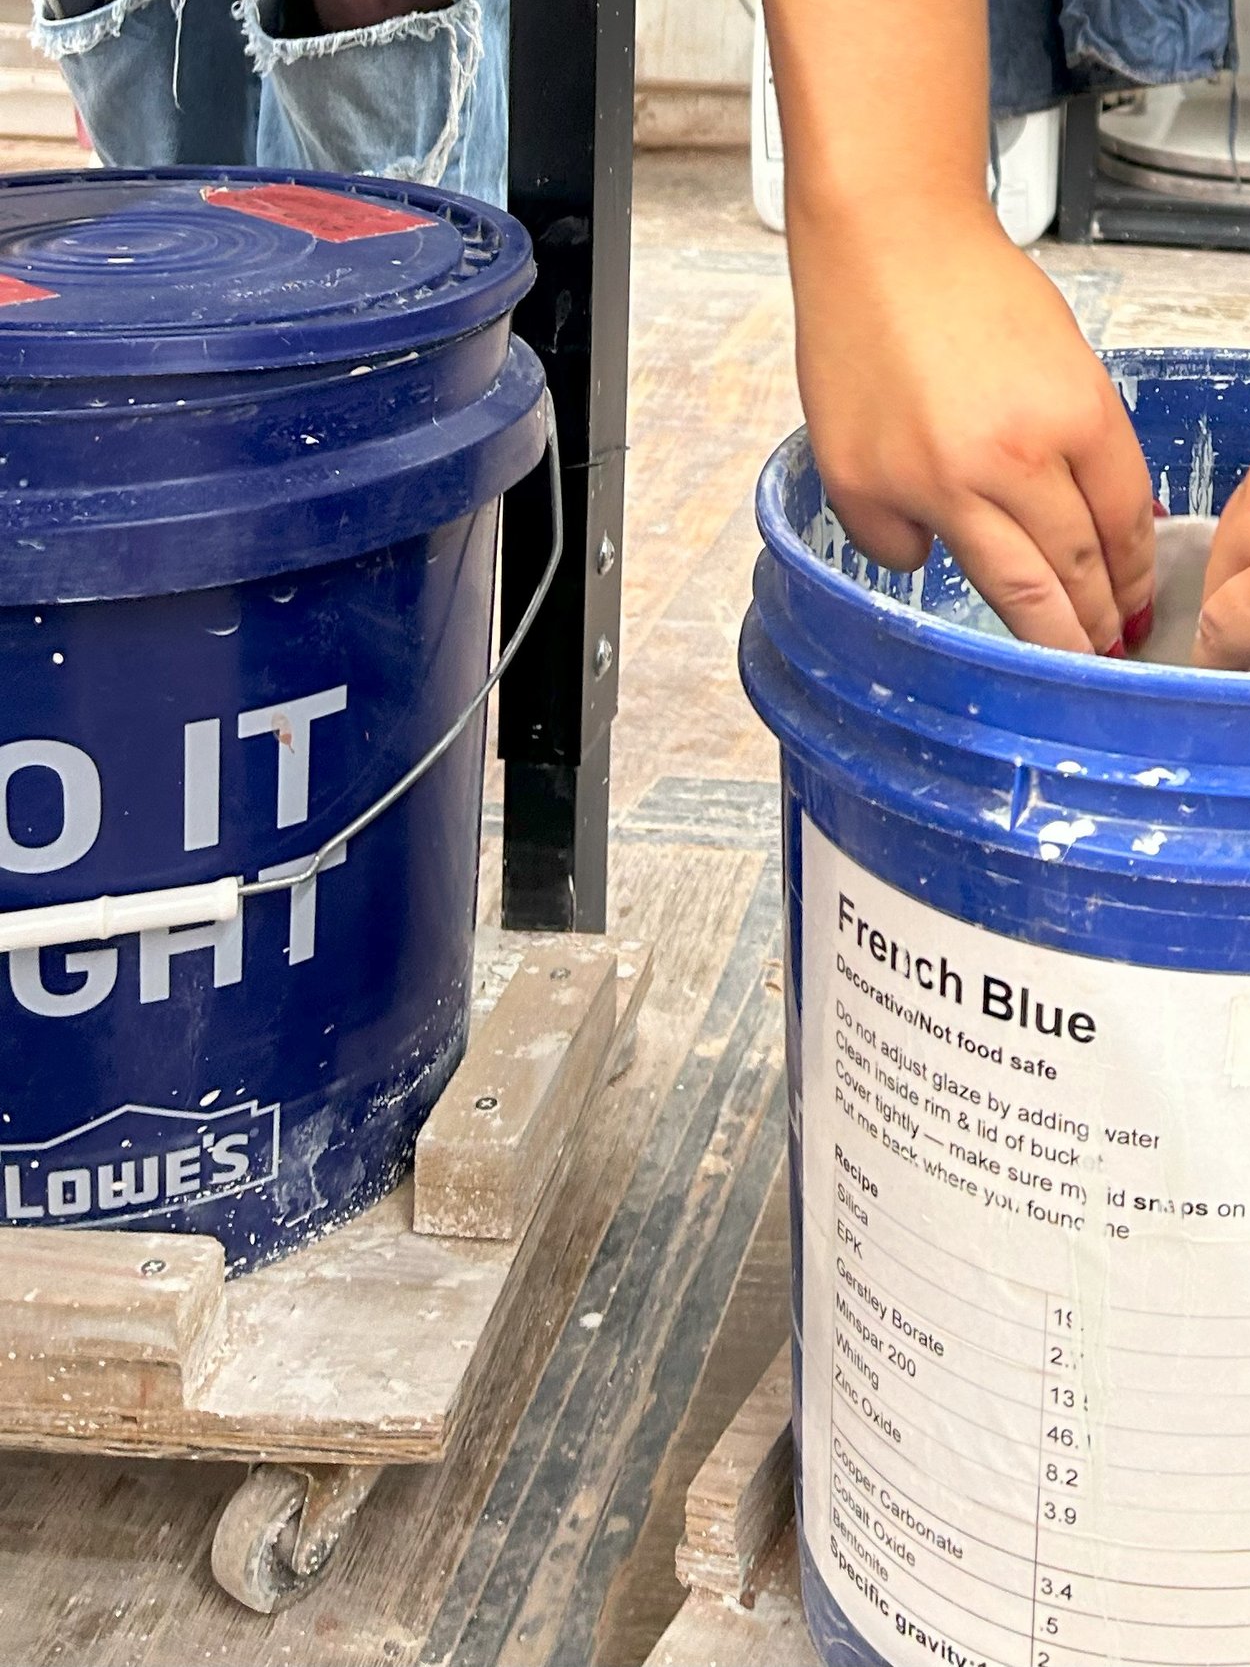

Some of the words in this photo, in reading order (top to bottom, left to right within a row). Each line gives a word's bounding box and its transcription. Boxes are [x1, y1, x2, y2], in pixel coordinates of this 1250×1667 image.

[183, 685, 348, 852] IT
[838, 890, 963, 1006] French
[982, 974, 1097, 1045] Blue
[835, 998, 854, 1029] Do
[855, 1020, 878, 1050] not
[880, 1040, 928, 1082] adjust
[932, 1072, 982, 1107] glaze
[987, 1091, 1012, 1120] by
[1017, 1107, 1091, 1143] adding
[835, 1029, 872, 1075] Clean
[874, 1061, 920, 1107] inside
[924, 1094, 952, 1124] rim
[957, 1111, 971, 1133] &
[977, 1118, 999, 1144] lid
[1004, 1134, 1026, 1153] of
[956, 1030, 1004, 1066] food
[1010, 1052, 1058, 1082] safe
[4, 1131, 250, 1220] LOWE'S
[834, 1142, 880, 1199] Recipe
[835, 1058, 873, 1103] Cover
[875, 1093, 920, 1140] tightly
[949, 1141, 1001, 1177] make
[1007, 1165, 1053, 1193] sure
[1217, 1202, 1247, 1219] on
[835, 1085, 856, 1121] Put
[857, 1111, 879, 1140] me
[881, 1127, 920, 1169] back
[922, 1156, 979, 1198] where
[836, 1218, 863, 1260] EPK
[837, 1182, 869, 1227] Silica
[835, 1291, 885, 1354] Minspar
[887, 1343, 917, 1378] 200
[836, 1256, 888, 1320] Gerstley
[891, 1308, 945, 1358] Borate
[835, 1327, 880, 1391] Whiting
[834, 1364, 859, 1405] Zinc
[861, 1397, 902, 1444] Oxide
[833, 1437, 878, 1496] Copper
[879, 1489, 964, 1560] Carbonate
[1043, 1500, 1077, 1526] 3.9
[1045, 1463, 1079, 1488] 8.2
[832, 1507, 890, 1583] Bentonite
[833, 1473, 871, 1531] Cobalt
[873, 1520, 917, 1568] Oxide
[830, 1534, 890, 1617] Specific
[1040, 1576, 1073, 1601] 3.4
[1039, 1615, 1059, 1635] .5
